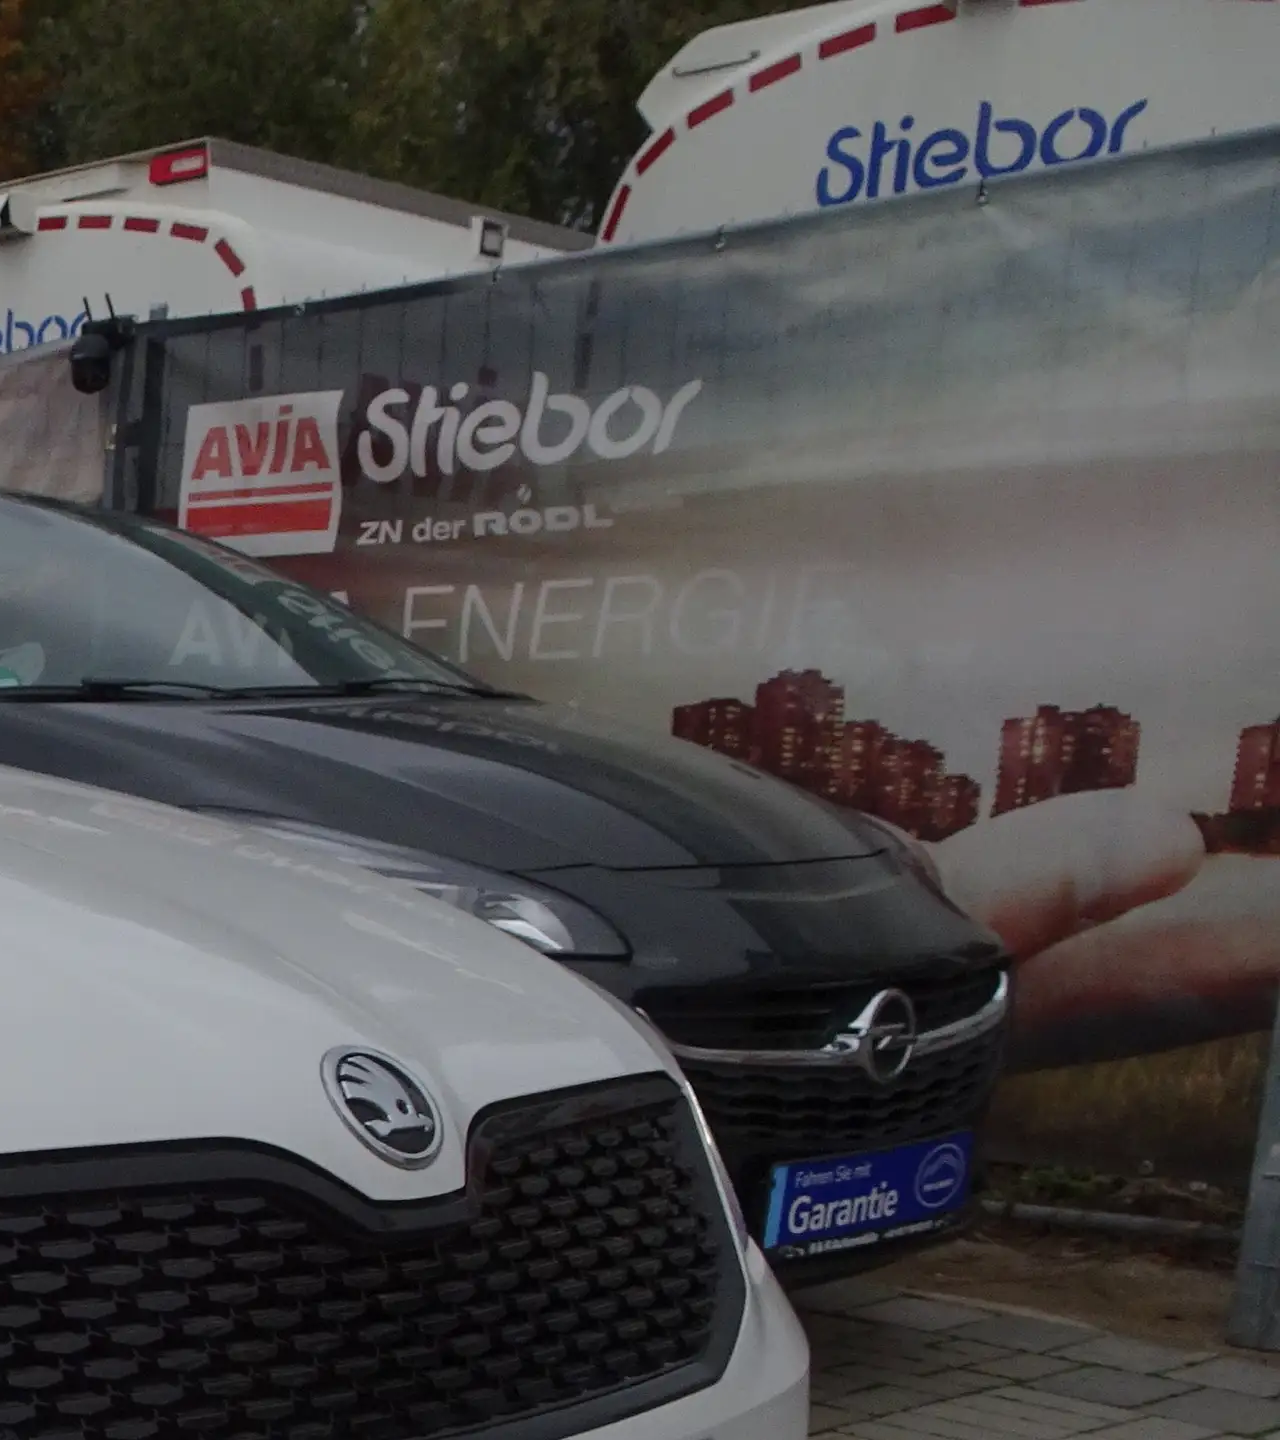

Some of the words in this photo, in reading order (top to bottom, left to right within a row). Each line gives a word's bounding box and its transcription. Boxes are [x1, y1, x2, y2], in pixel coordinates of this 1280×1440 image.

[816, 98, 1148, 207] Stiebor
[357, 370, 704, 484] Stiebor
[356, 519, 403, 545] ZN
[412, 513, 466, 542] der
[788, 1181, 898, 1234] Garantie
